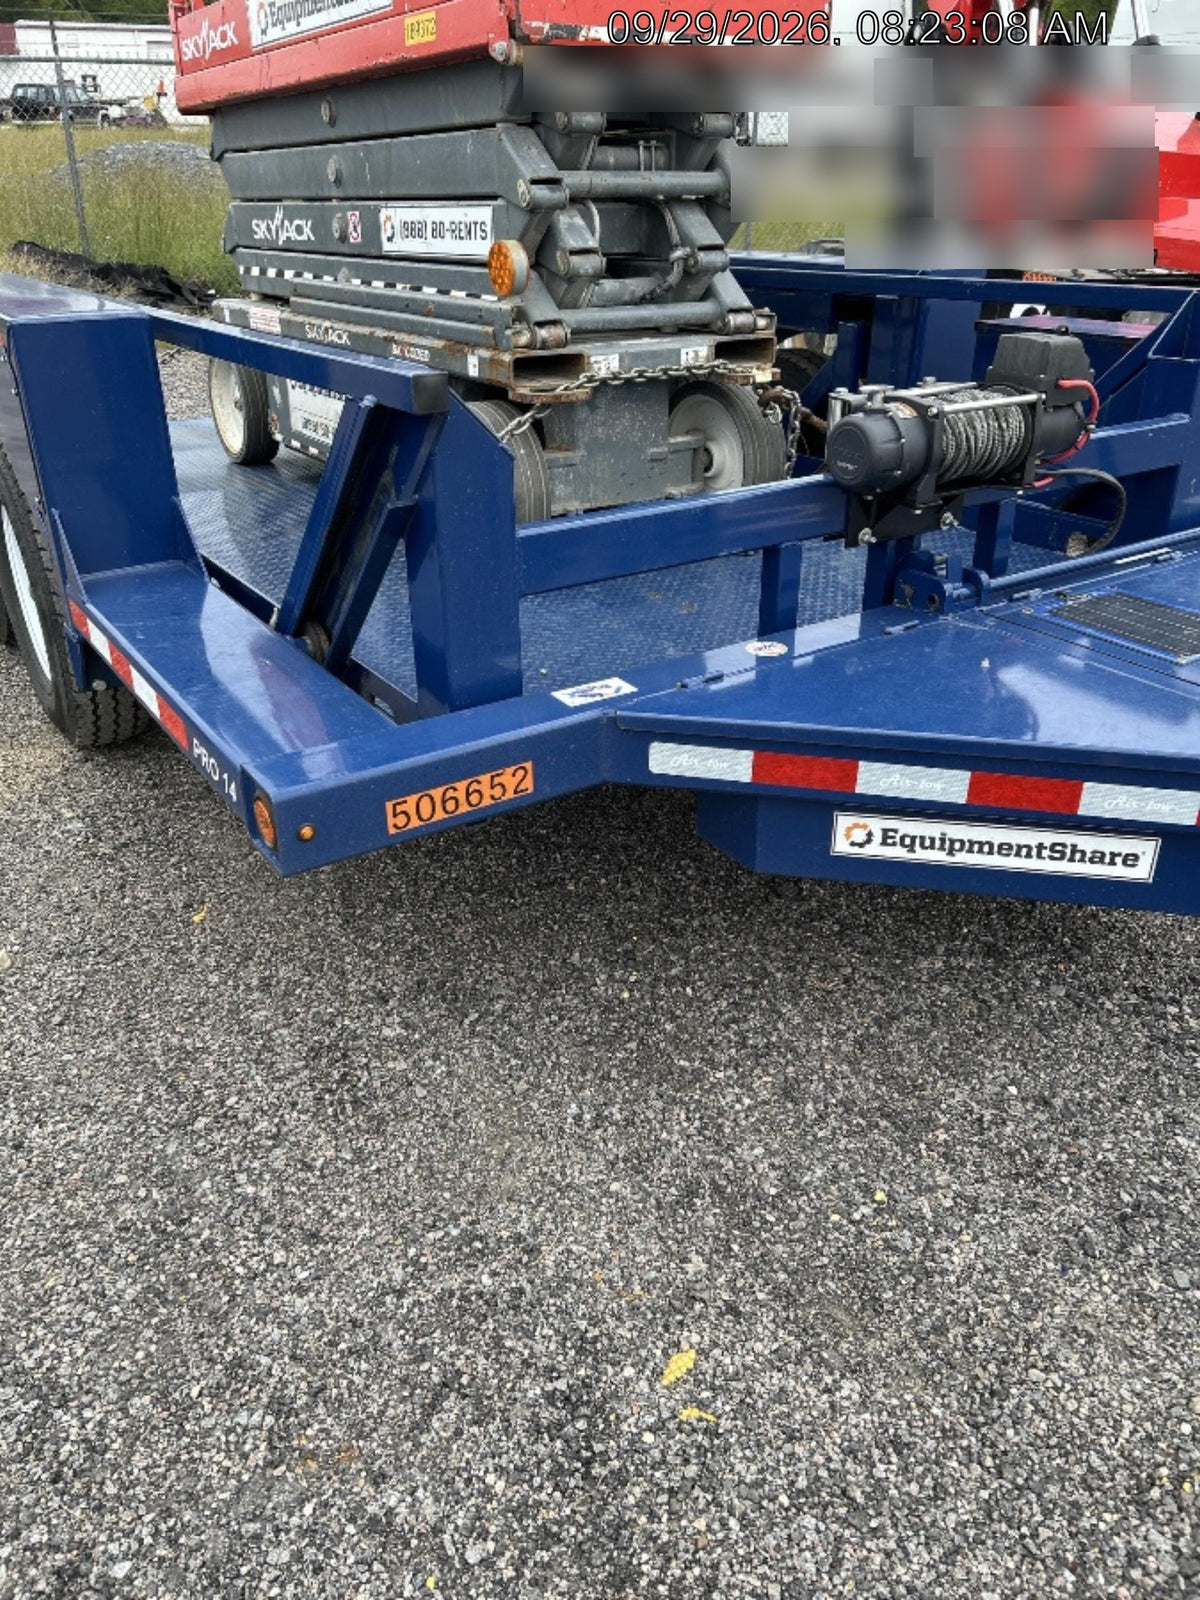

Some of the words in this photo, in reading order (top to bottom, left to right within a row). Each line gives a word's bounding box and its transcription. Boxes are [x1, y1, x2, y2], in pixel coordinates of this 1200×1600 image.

[181, 16, 239, 61] SKYJACK
[251, 205, 315, 246] SKYJACK
[431, 220, 488, 241] 80-RENTS
[193, 737, 219, 782] PRO
[222, 772, 237, 802] 14
[391, 765, 530, 831] 506652
[879, 827, 1141, 868] EquipmentShare
